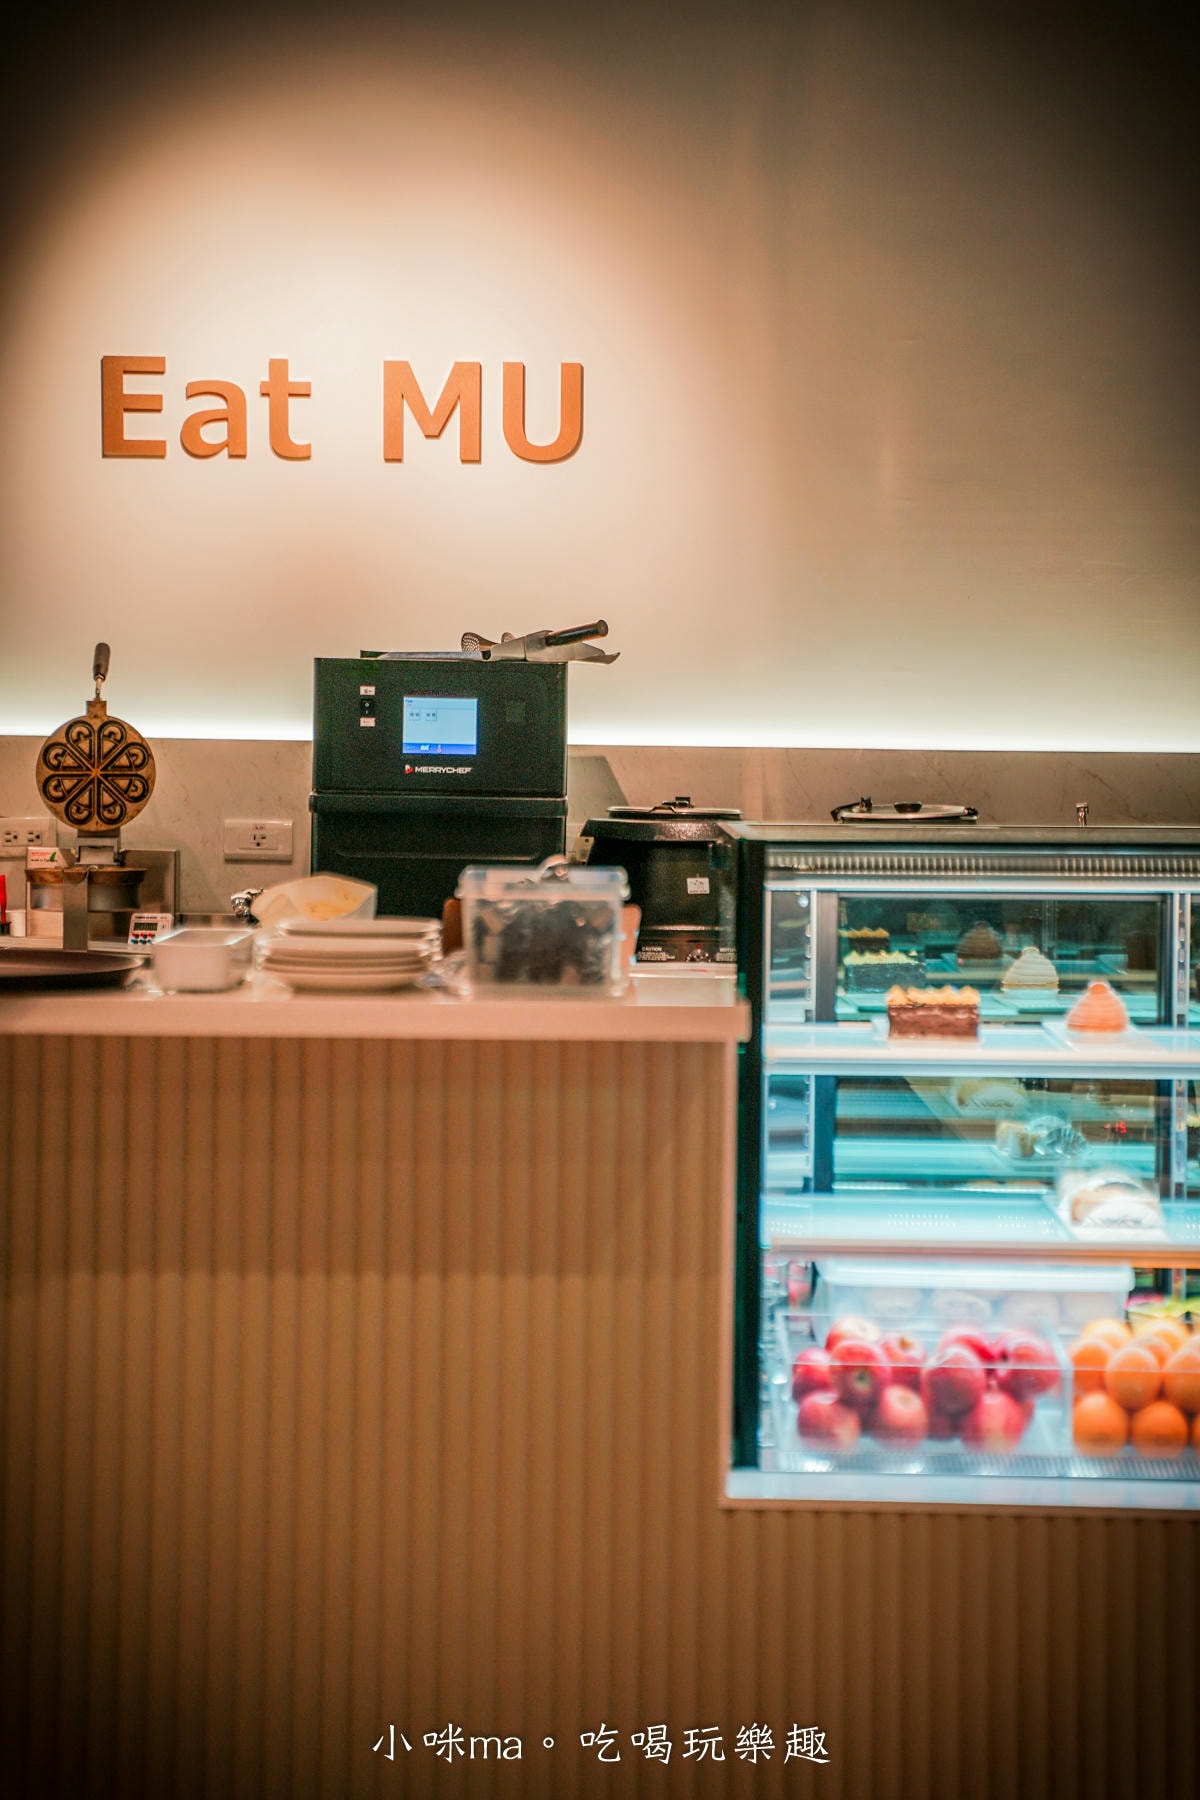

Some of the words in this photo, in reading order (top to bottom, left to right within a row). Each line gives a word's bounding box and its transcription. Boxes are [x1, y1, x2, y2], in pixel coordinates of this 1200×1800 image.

[101, 355, 312, 461] Eat
[383, 360, 584, 465] MU
[414, 765, 473, 775] MERRYCHEF
